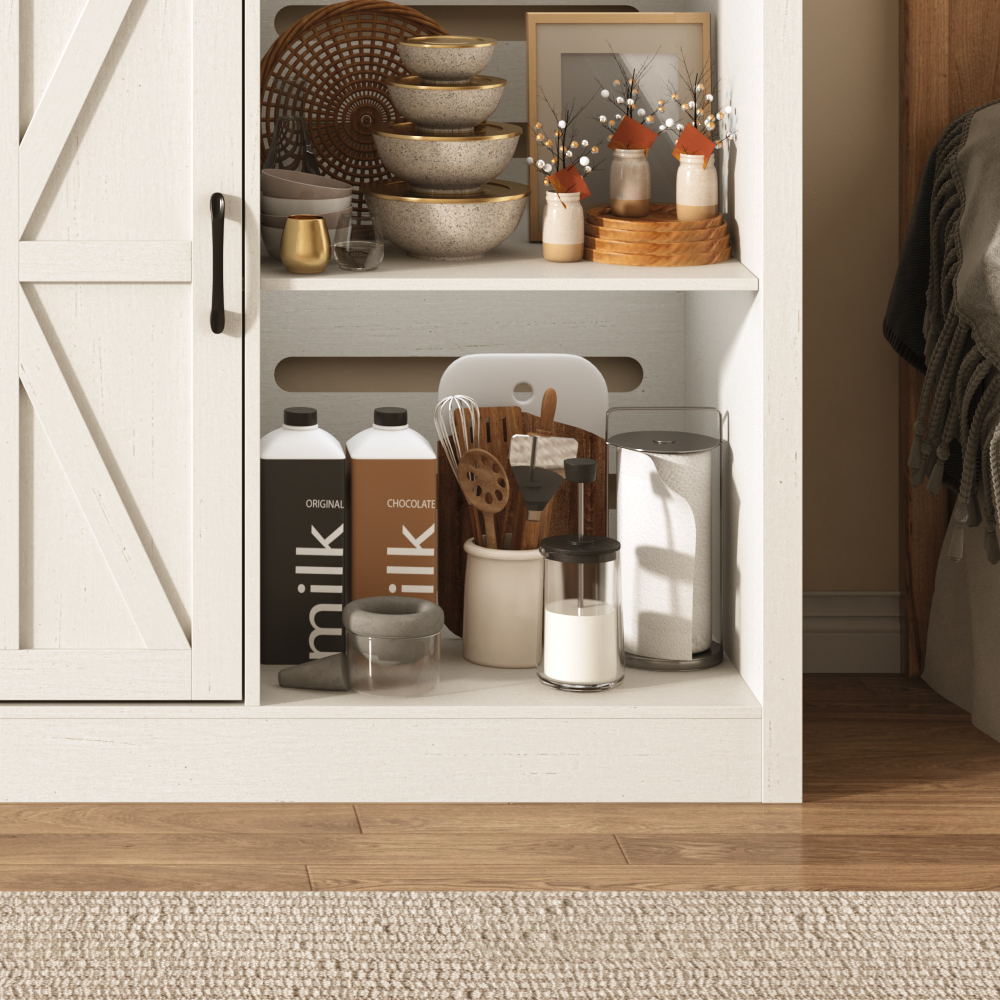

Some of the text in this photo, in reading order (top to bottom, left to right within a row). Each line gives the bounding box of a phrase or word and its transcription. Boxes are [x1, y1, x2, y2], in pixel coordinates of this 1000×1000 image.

[305, 499, 345, 509] ORIGINAL
[386, 498, 436, 509] CHOCOLATE
[386, 523, 436, 594] ilk
[295, 523, 345, 660] milk
